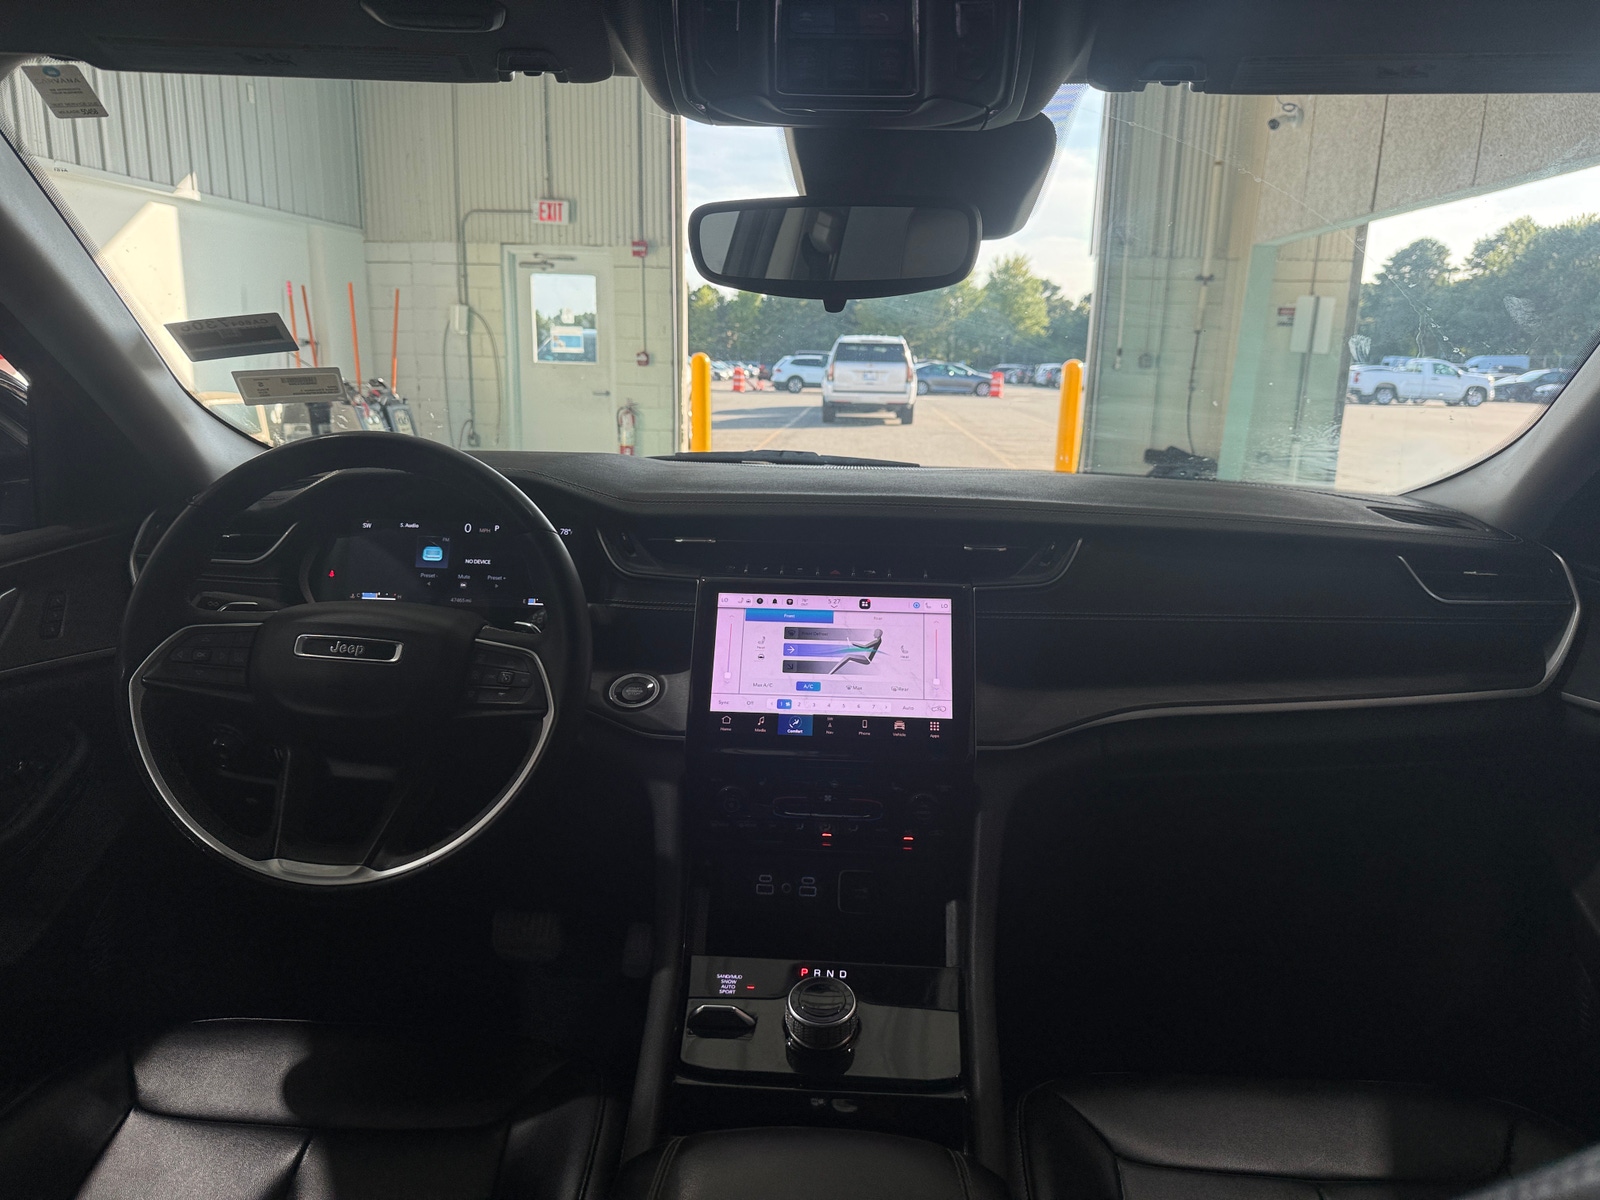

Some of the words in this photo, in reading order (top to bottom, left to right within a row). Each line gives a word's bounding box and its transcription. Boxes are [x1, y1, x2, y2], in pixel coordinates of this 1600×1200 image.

[539, 200, 563, 223] EXIT
[464, 523, 472, 534] 0
[494, 524, 500, 532] P
[329, 640, 365, 656] Jeep
[801, 967, 809, 977] P
[813, 968, 821, 977] R
[827, 969, 835, 978] N
[839, 969, 848, 979] D
